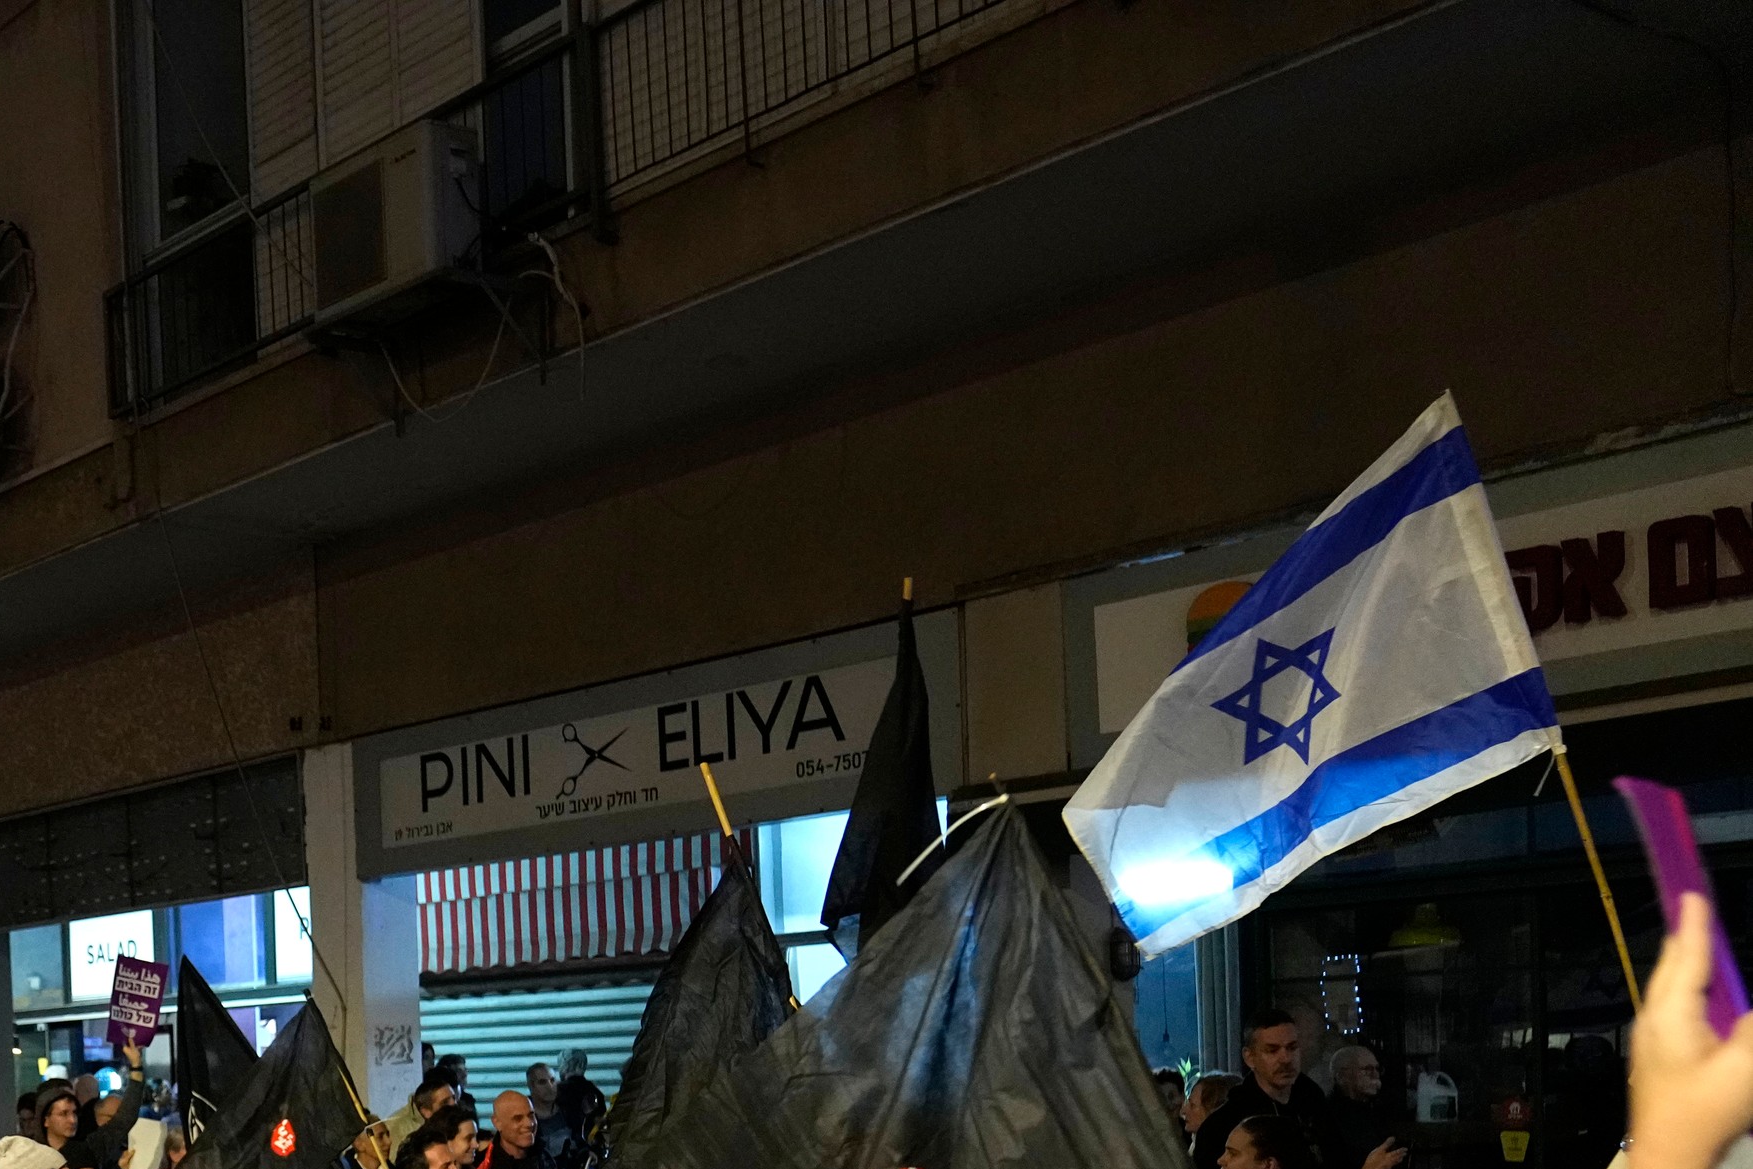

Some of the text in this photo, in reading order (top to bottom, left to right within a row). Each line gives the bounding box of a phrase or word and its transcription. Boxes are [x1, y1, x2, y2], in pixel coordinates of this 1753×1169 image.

[420, 675, 845, 812] PINI ELIYA
[536, 787, 658, 818] חד וחלק עיצוב שיער
[87, 940, 136, 964] SALAD
[116, 979, 157, 996] זה הבית
[136, 1010, 153, 1024] של
